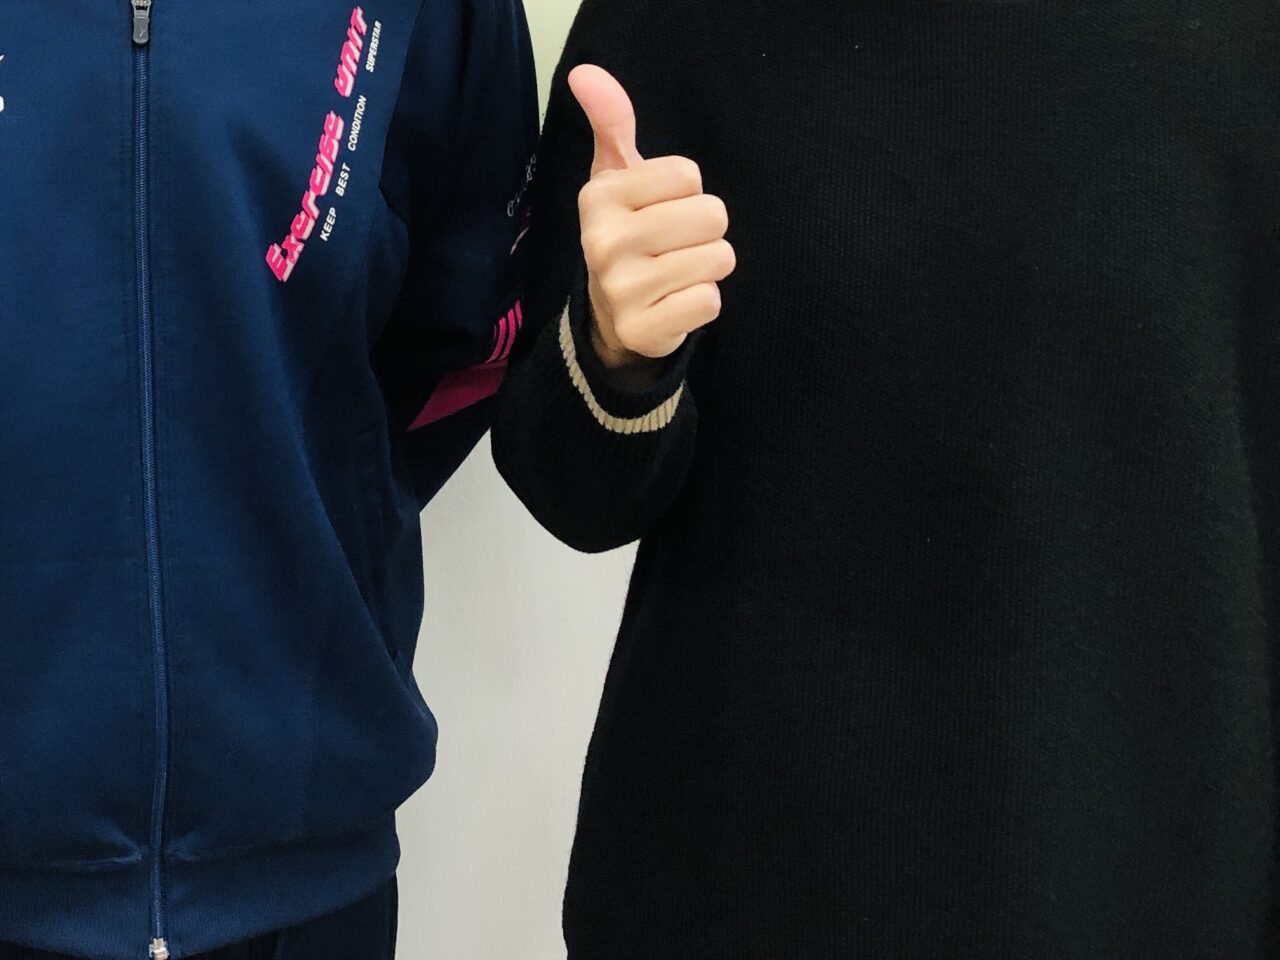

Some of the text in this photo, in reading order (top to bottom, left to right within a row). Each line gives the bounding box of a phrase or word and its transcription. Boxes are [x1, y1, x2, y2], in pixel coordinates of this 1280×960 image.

[319, 20, 382, 242] KEEP BEST CONDITION SUPERSTAR
